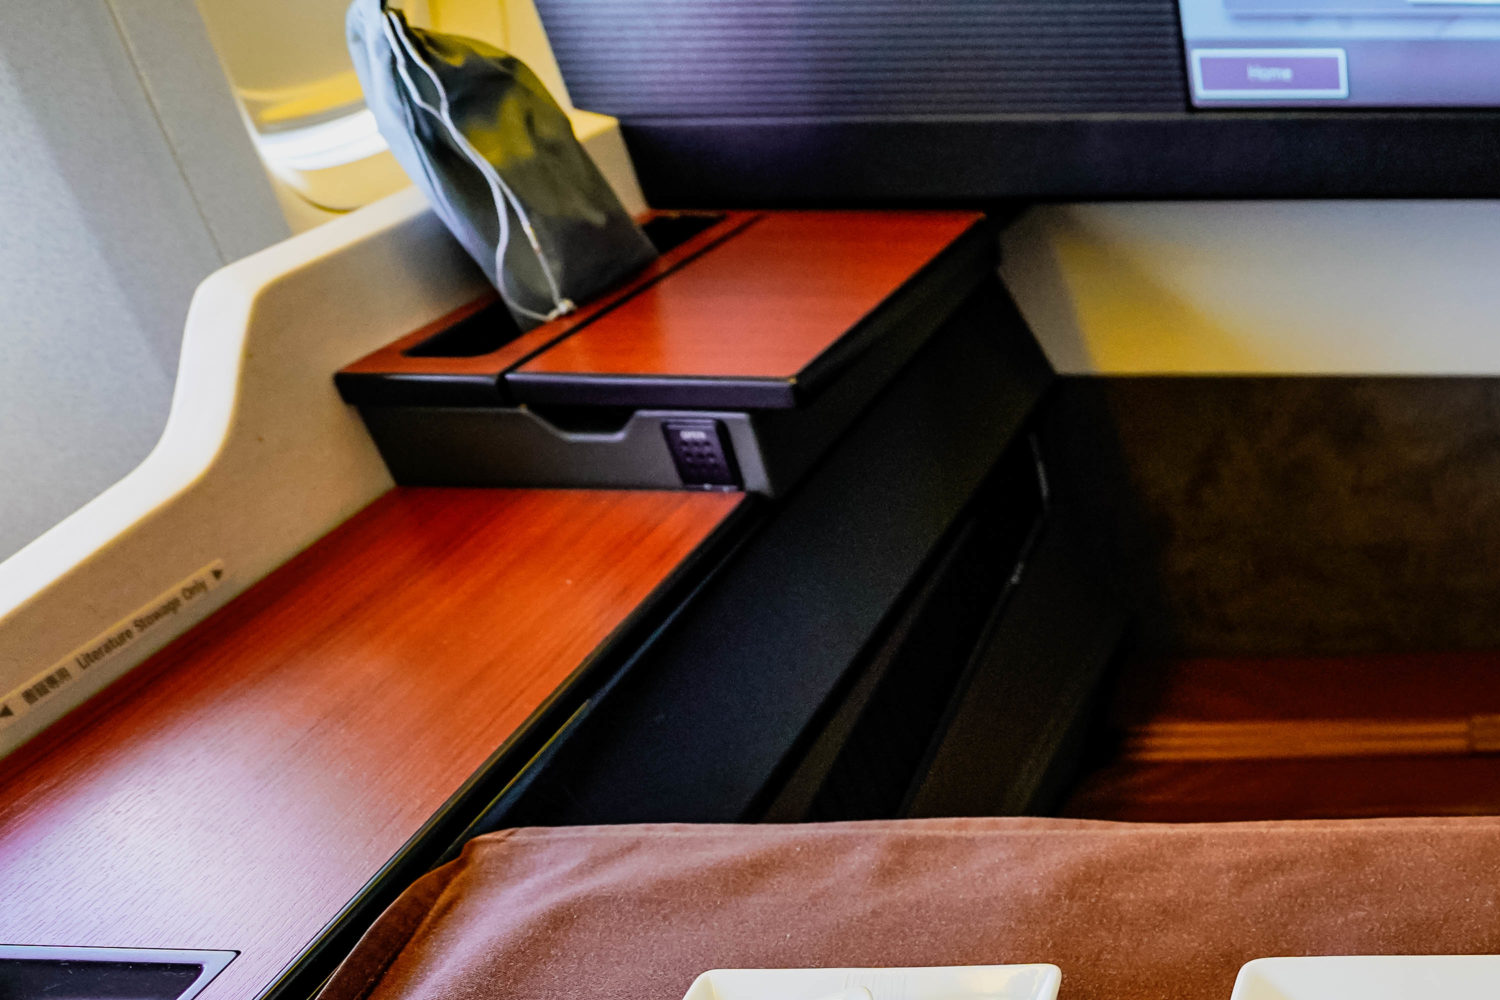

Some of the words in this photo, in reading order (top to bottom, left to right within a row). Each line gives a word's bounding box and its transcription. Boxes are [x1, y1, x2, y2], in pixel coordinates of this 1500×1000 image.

[76, 629, 134, 670] Literature
[133, 598, 181, 632] Stowage
[182, 580, 208, 600] Only
